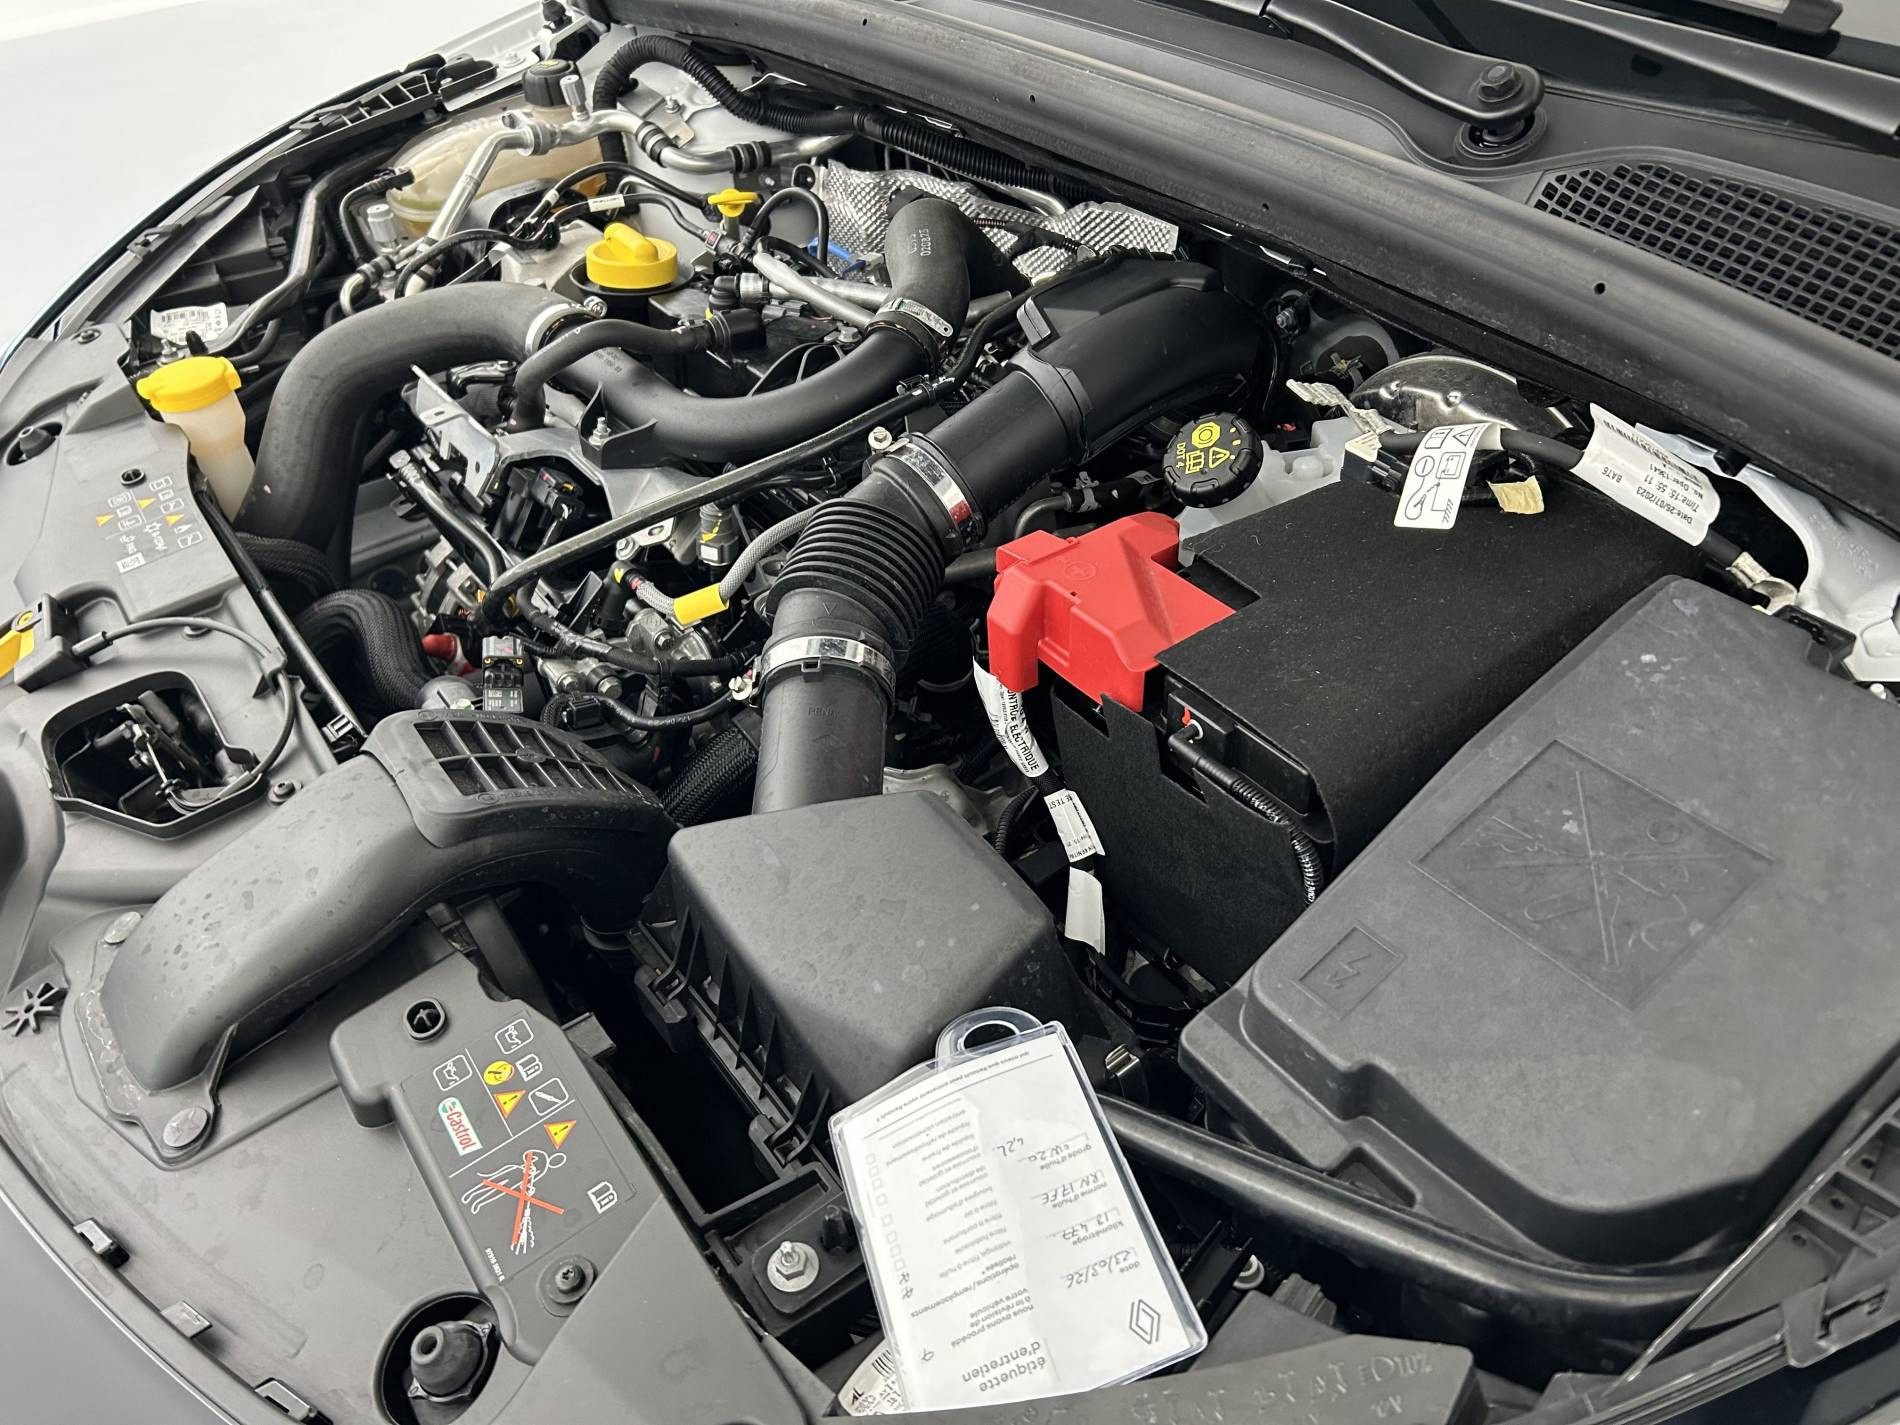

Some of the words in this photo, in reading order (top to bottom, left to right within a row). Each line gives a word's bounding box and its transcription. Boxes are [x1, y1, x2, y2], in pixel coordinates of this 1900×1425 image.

[1176, 442, 1186, 459] DOT
[1176, 461, 1184, 469] 4
[1602, 467, 1623, 483] BAT6
[1049, 798, 1065, 809] TEST
[446, 1111, 477, 1151] Castrol
[1120, 1261, 1140, 1273] date
[1012, 1304, 1034, 1317] nous
[986, 1313, 1012, 1329] avons
[962, 1341, 1041, 1382] d'entretien
[978, 1356, 1046, 1392] étiquette
